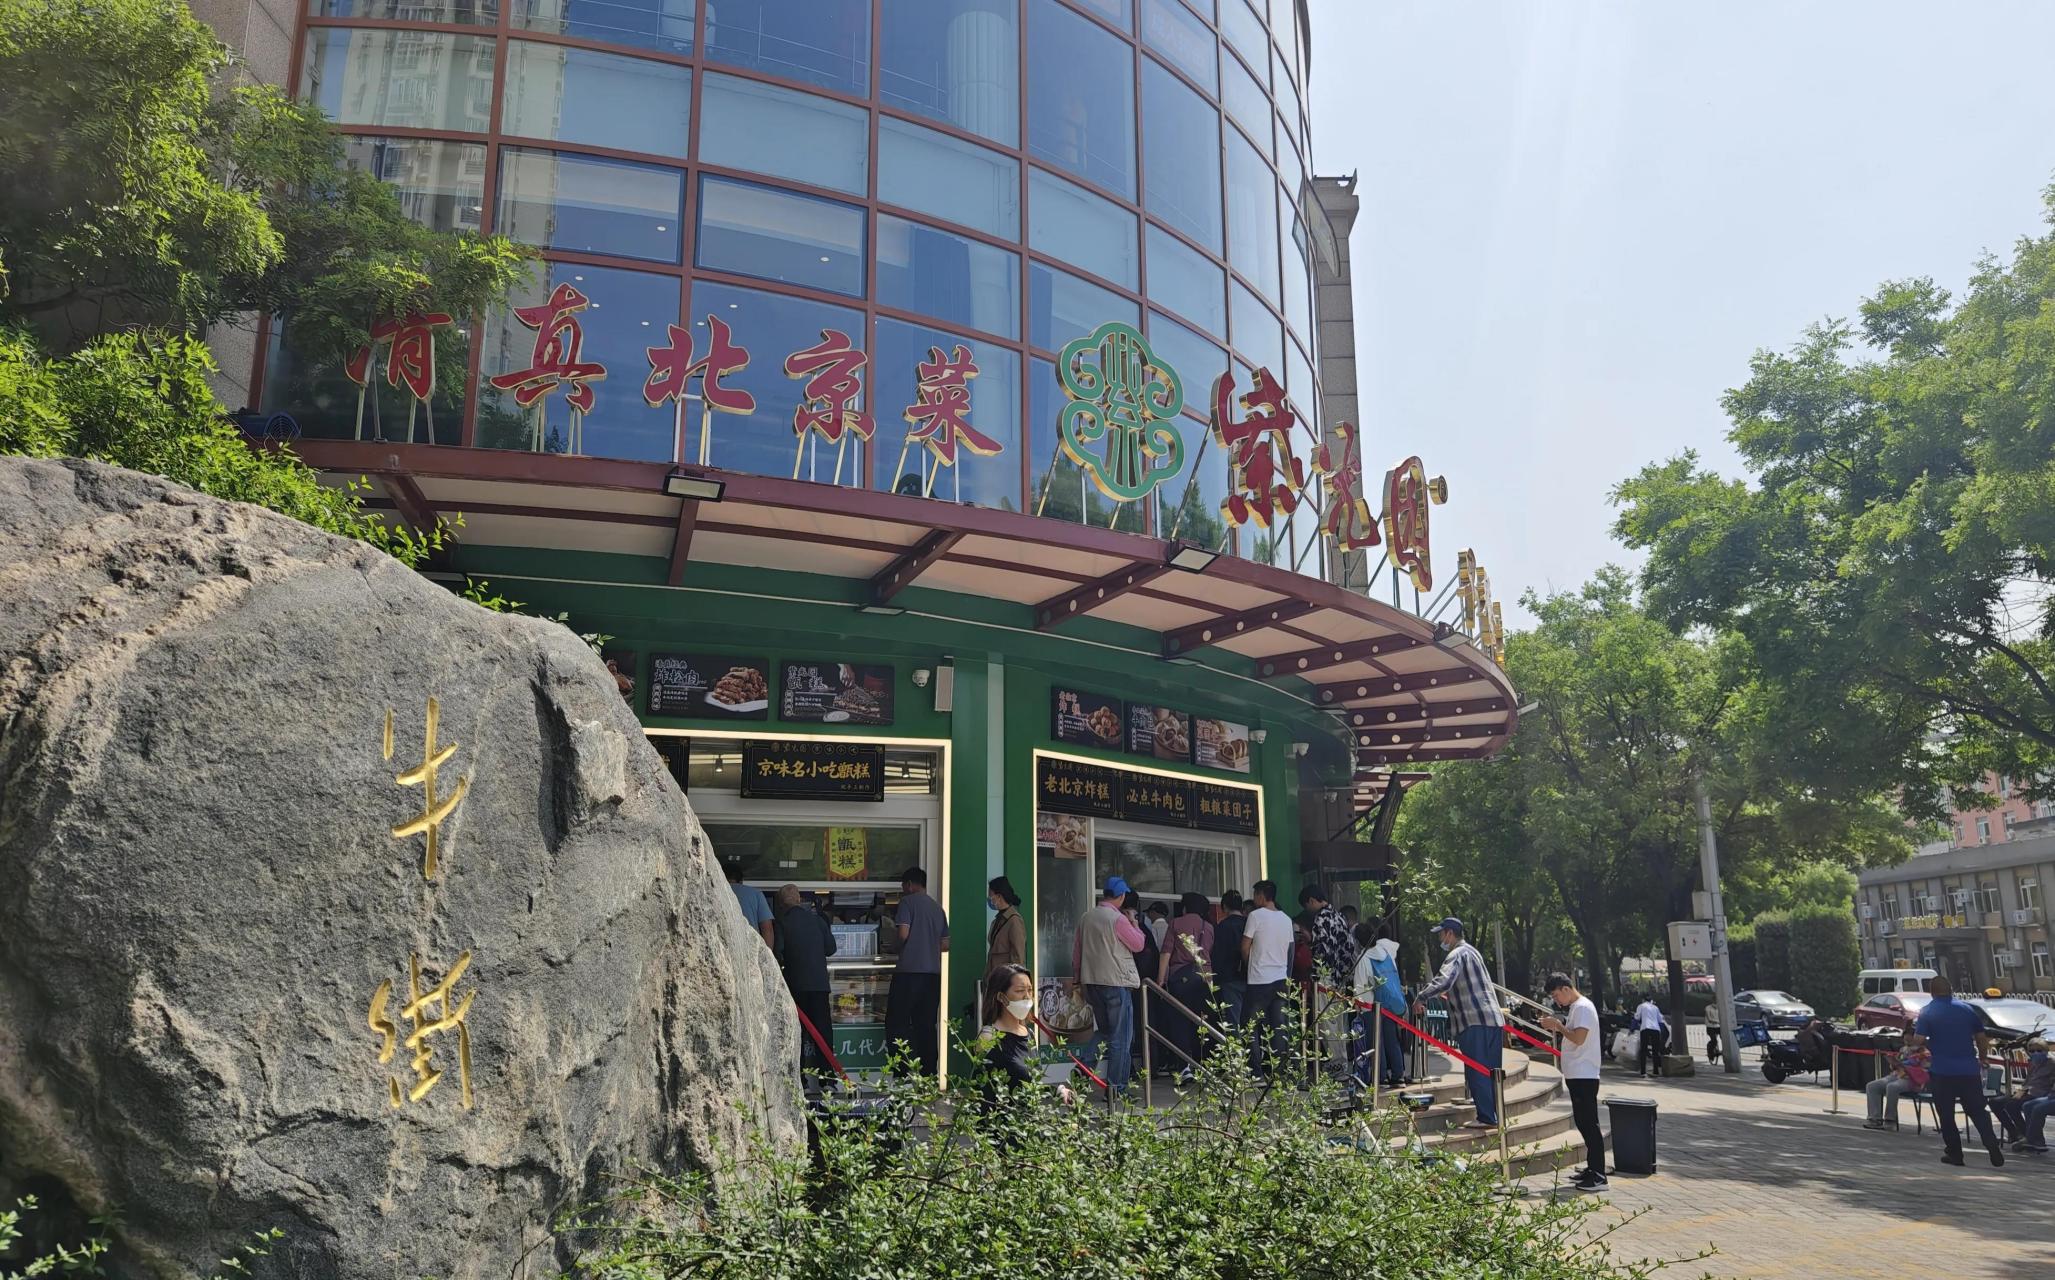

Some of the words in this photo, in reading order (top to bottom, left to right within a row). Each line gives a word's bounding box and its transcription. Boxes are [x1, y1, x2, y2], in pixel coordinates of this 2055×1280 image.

[757, 758, 871, 780] 京味名小吃甑糕
[1044, 773, 1110, 800] 老北京炸糕
[1126, 787, 1185, 812] 必点牛肉包
